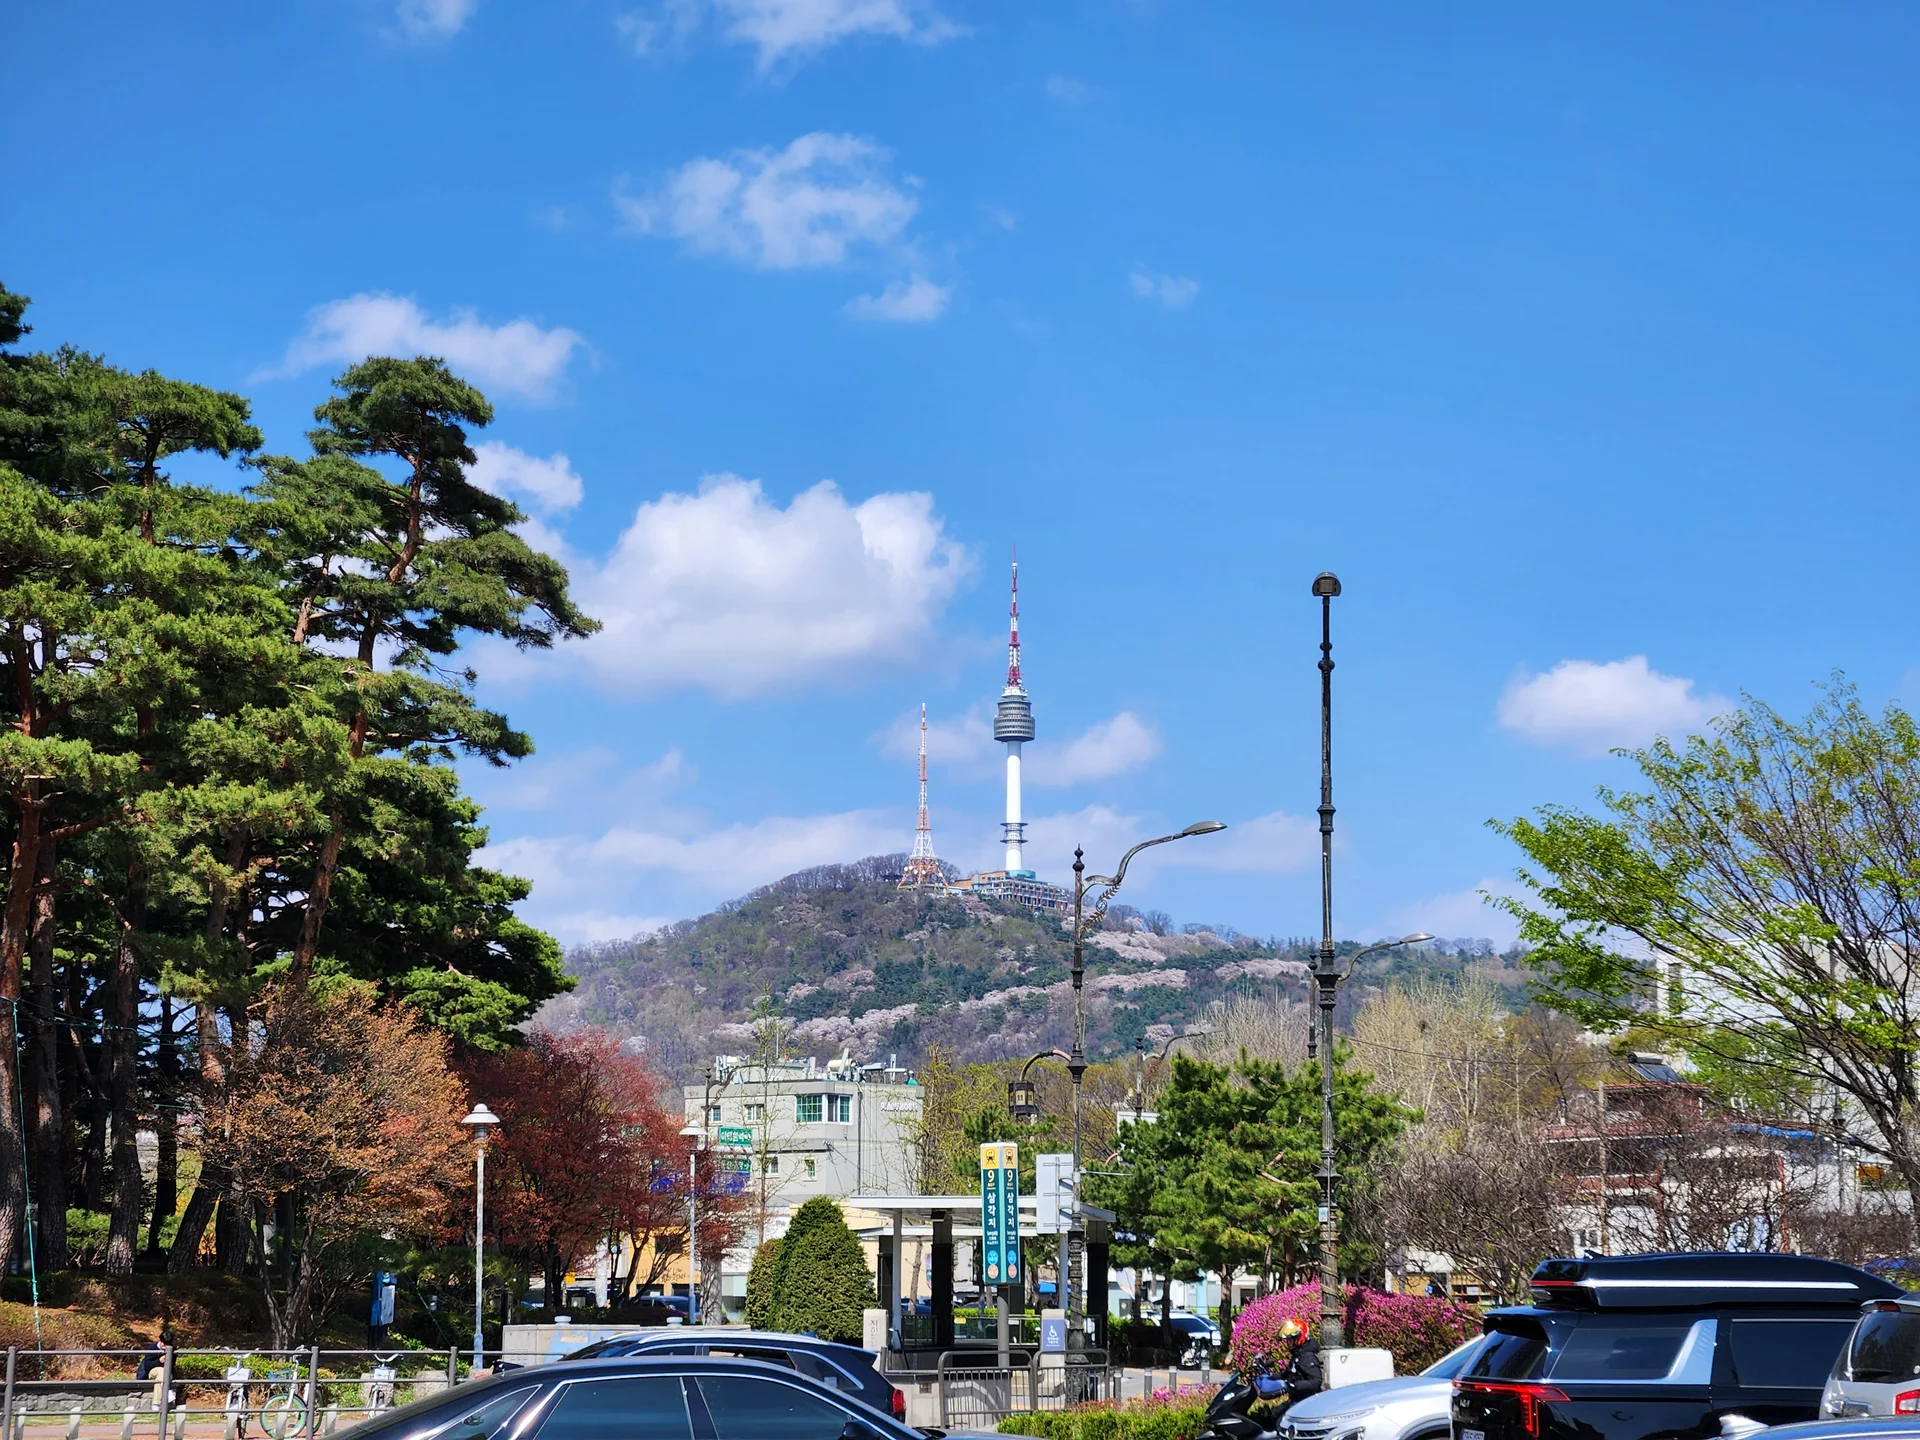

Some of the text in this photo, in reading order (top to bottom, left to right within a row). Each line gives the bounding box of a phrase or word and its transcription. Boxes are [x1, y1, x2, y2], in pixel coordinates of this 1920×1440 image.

[987, 1170, 995, 1182] 9
[1007, 1170, 1013, 1182] 9
[987, 1192, 996, 1229] 삼각지
[1006, 1192, 1015, 1228] 삼각지
